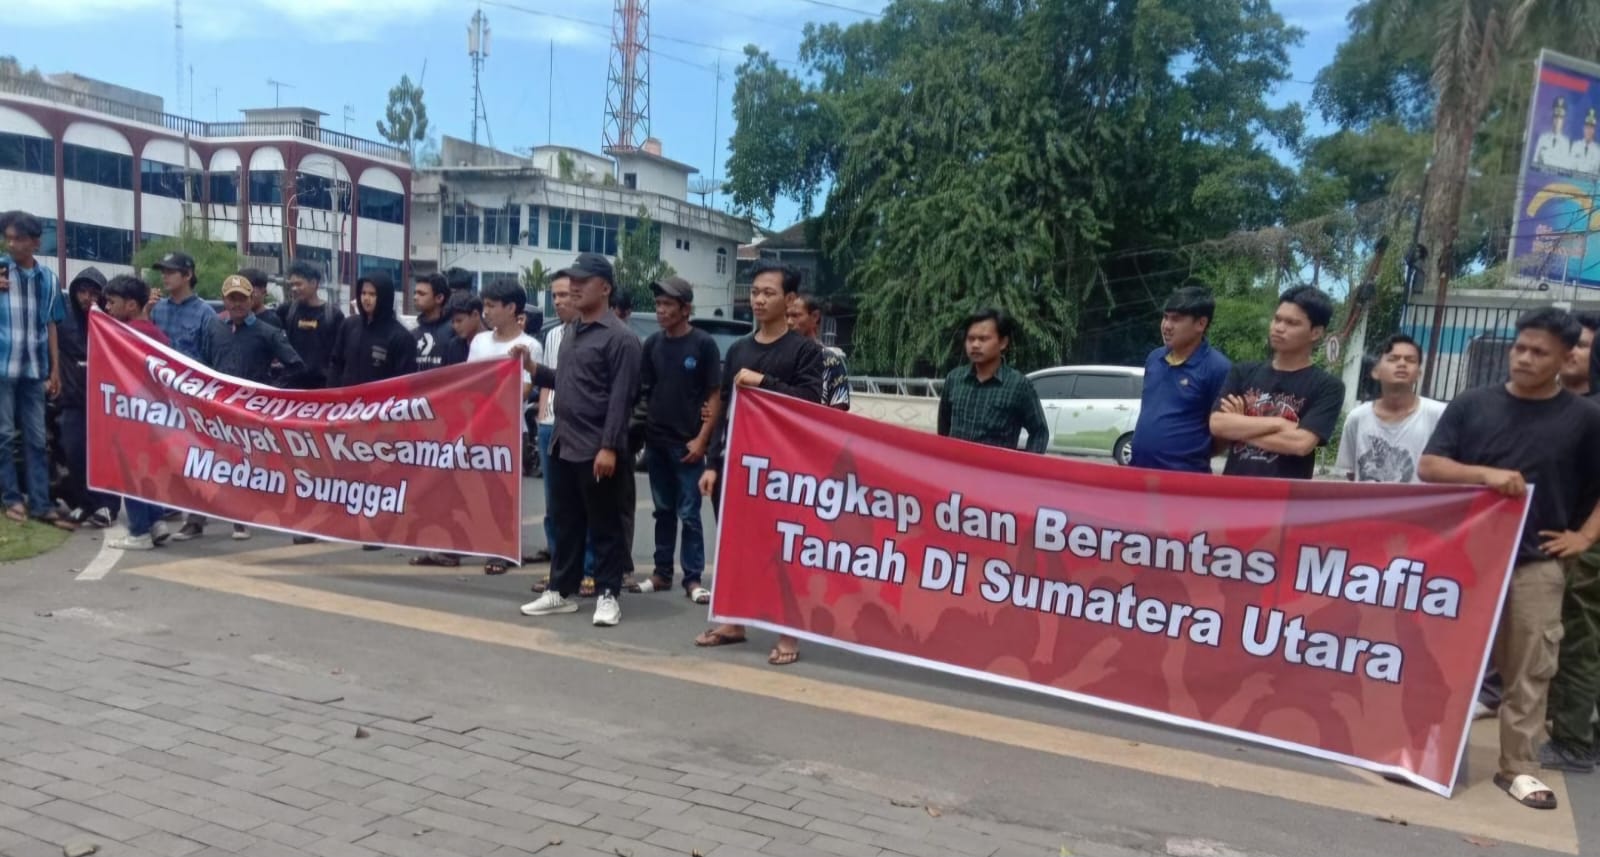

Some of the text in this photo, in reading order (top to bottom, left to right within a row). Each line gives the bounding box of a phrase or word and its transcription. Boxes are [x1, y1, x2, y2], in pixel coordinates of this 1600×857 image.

[100, 383, 513, 474] Tanah Rakyat Di Kecamatan
[145, 354, 435, 422] Tolak Penyerobotan
[183, 446, 408, 519] Medan Sunggal
[741, 454, 1462, 619] Tangkap dan Berantas Mafia
[776, 521, 1405, 684] Tanah Di Sumatera Utara
